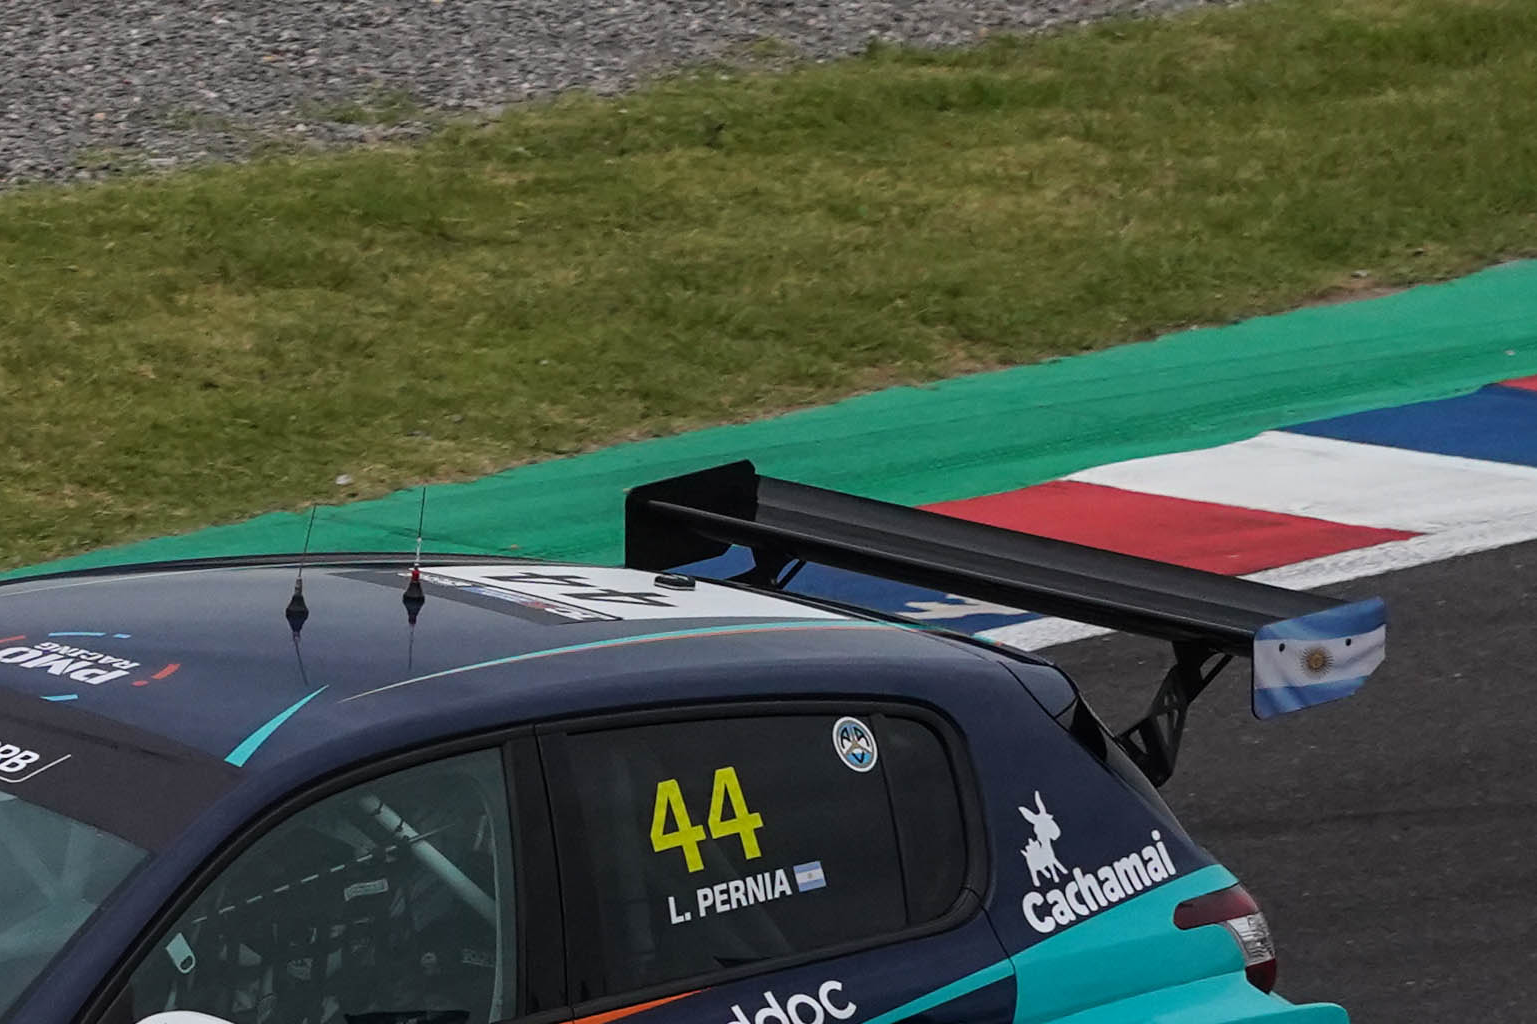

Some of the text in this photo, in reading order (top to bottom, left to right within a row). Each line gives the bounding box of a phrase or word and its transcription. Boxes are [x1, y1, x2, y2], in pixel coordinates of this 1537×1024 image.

[34, 641, 141, 670] RACING
[650, 766, 764, 873] 44
[668, 868, 793, 925] L. PERNIA
[1022, 829, 1177, 934] Cachamai
